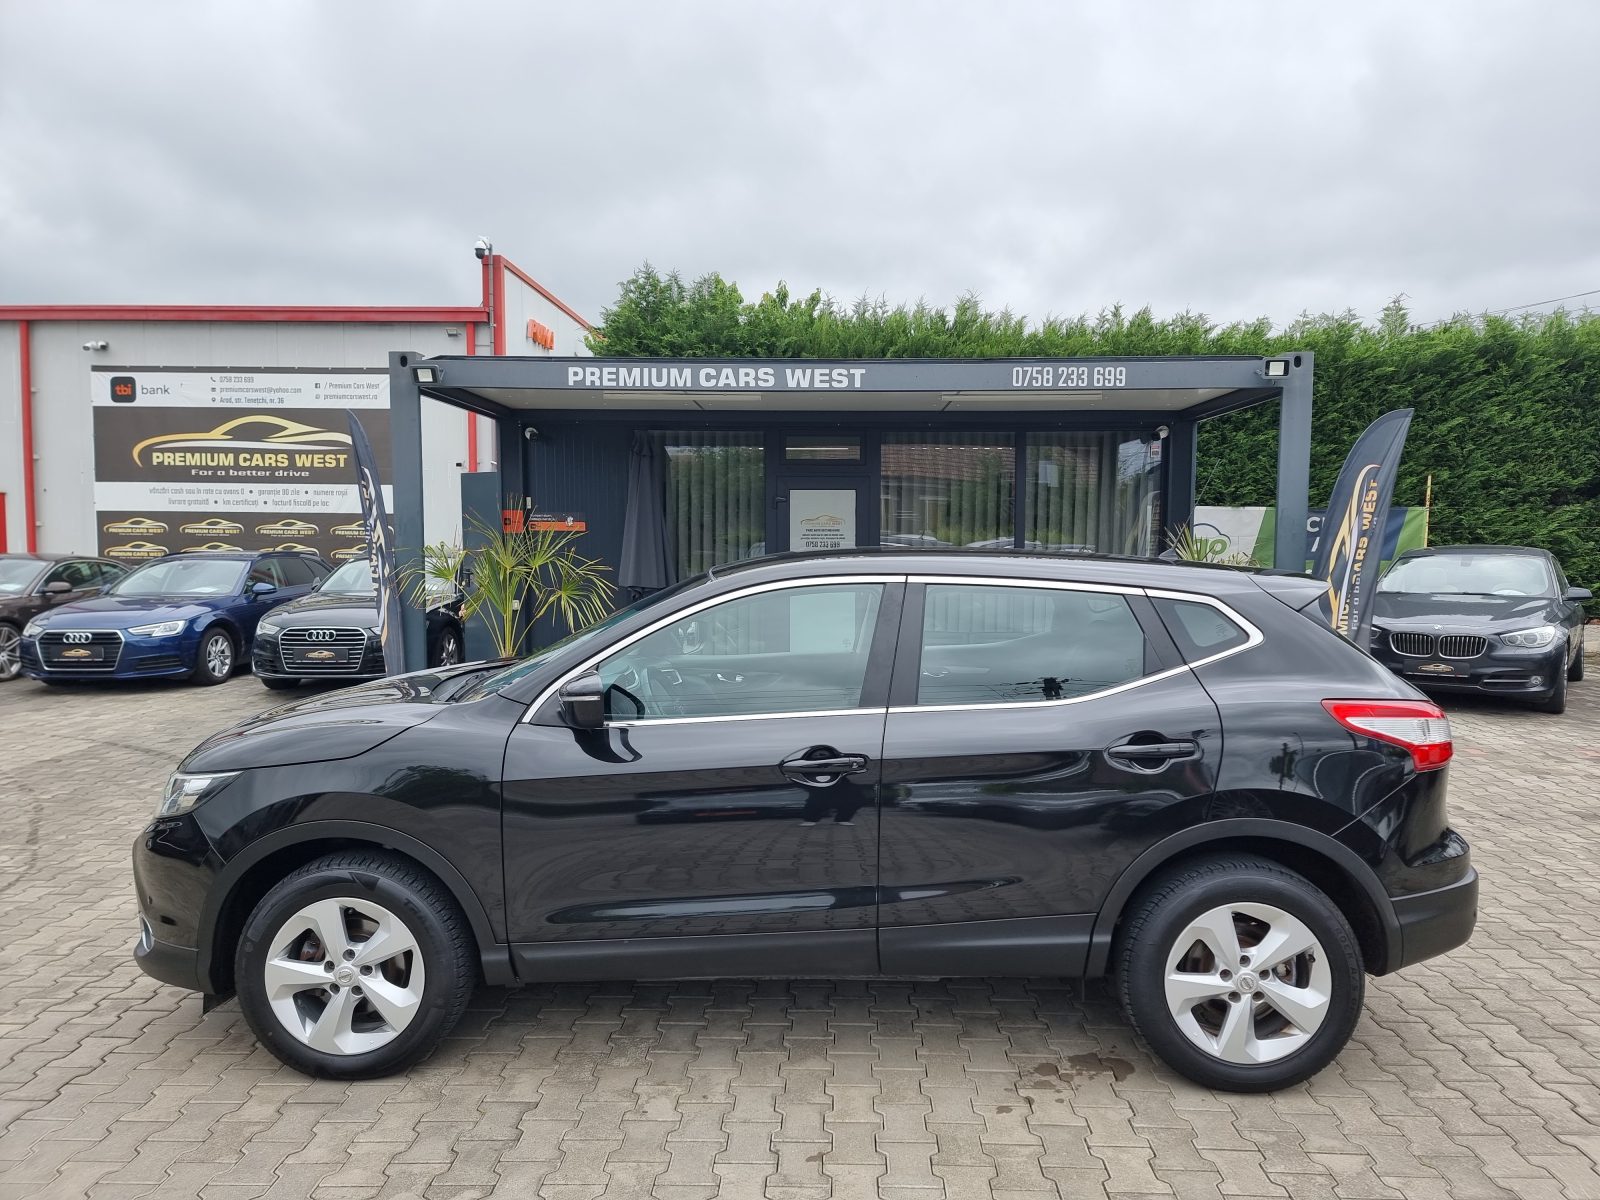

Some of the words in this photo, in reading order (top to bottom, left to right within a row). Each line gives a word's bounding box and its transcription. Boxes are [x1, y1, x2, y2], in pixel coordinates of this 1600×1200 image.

[568, 366, 692, 386] PREMIUM
[700, 368, 775, 387] CARS
[786, 368, 866, 388] WEST
[1012, 366, 1053, 386] 0758
[1058, 366, 1088, 386] 233
[1094, 366, 1126, 386] 699
[115, 384, 132, 395] tbi
[141, 385, 170, 394] bank
[152, 452, 234, 466] PREMIUM
[239, 453, 288, 467] CARS
[295, 454, 347, 468] WEST
[1362, 480, 1378, 530] WEST
